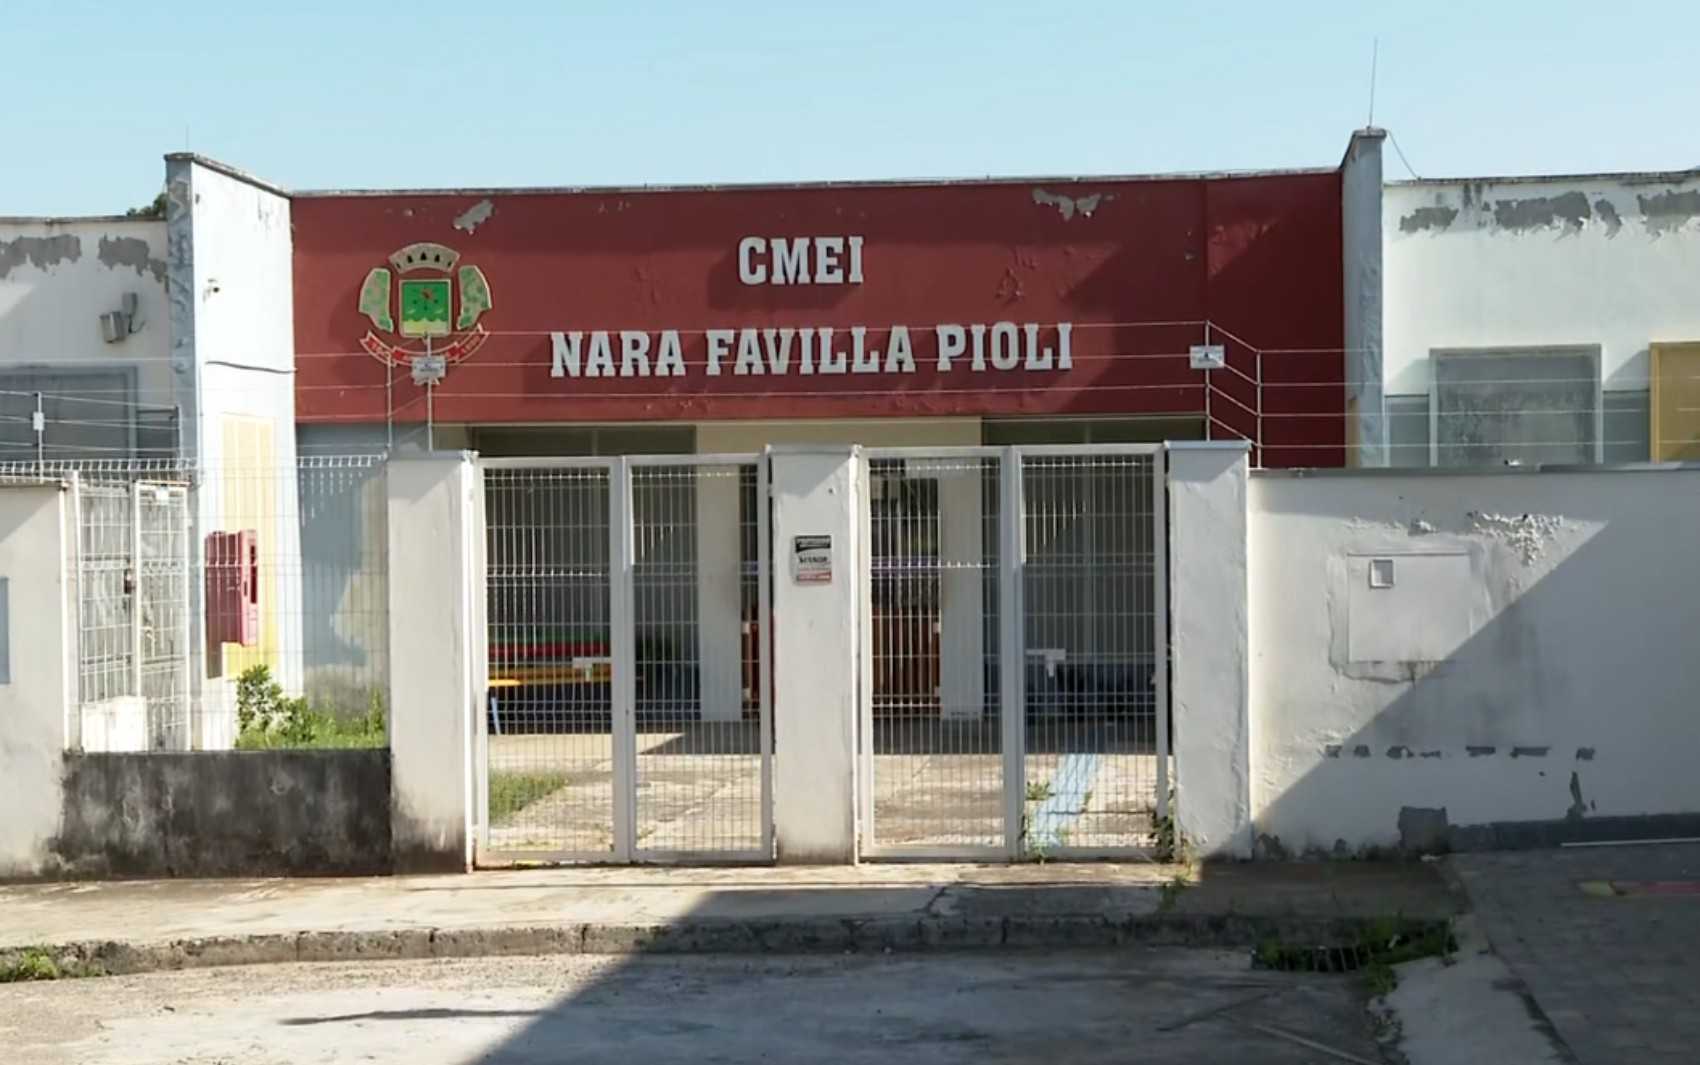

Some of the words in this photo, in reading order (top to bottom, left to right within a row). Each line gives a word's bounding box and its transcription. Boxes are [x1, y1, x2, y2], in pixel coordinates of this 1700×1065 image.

[738, 236, 864, 285] CMEI
[550, 330, 686, 377] NARA
[705, 325, 916, 376] FAVILLA
[936, 322, 1073, 371] PIOLI
